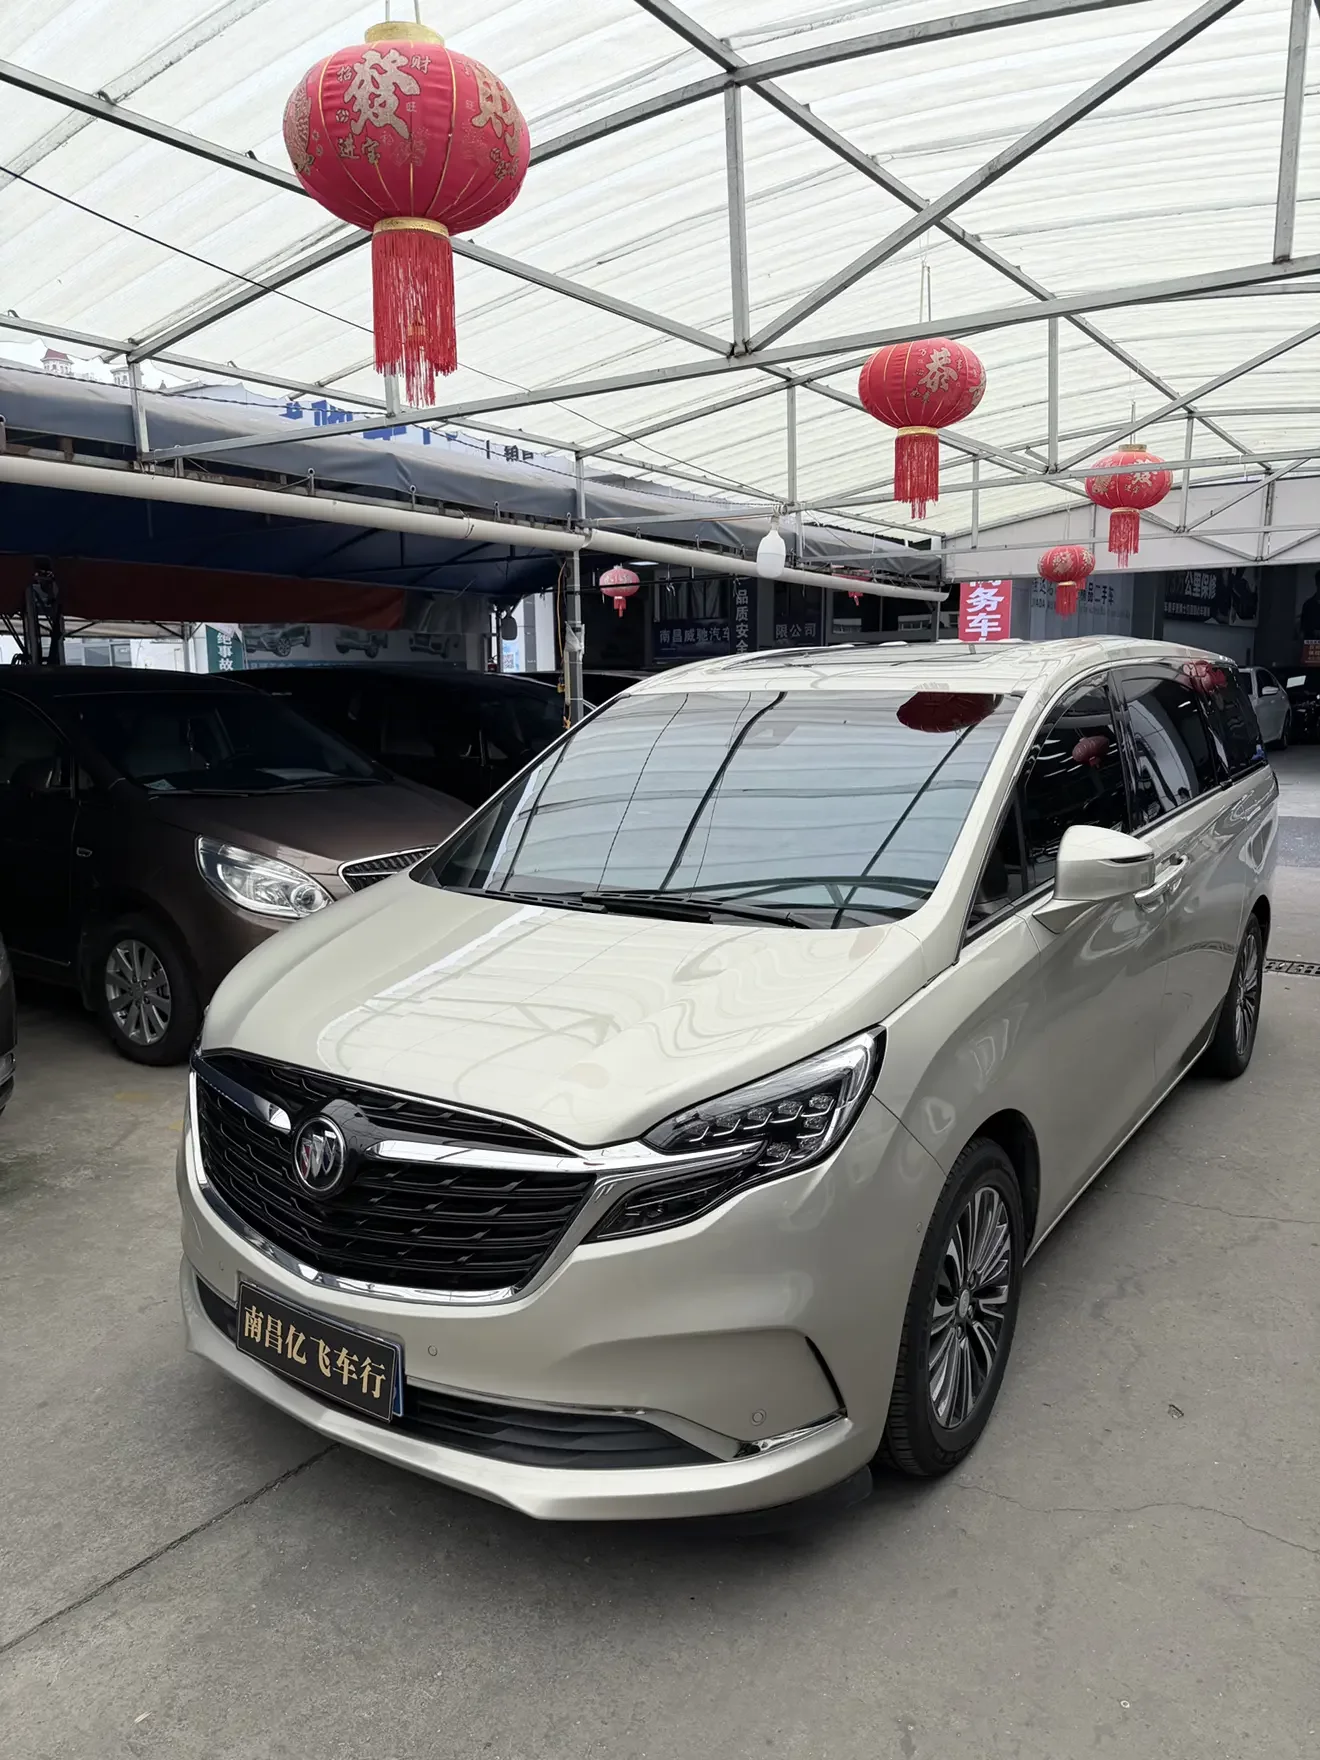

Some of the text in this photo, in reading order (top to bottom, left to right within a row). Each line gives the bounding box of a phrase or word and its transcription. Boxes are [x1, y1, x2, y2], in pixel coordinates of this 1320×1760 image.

[734, 588, 750, 653] 品质安全
[775, 622, 817, 639] 限公司
[964, 580, 1005, 641] 务车
[244, 1305, 386, 1399] 南昌亿飞车行
